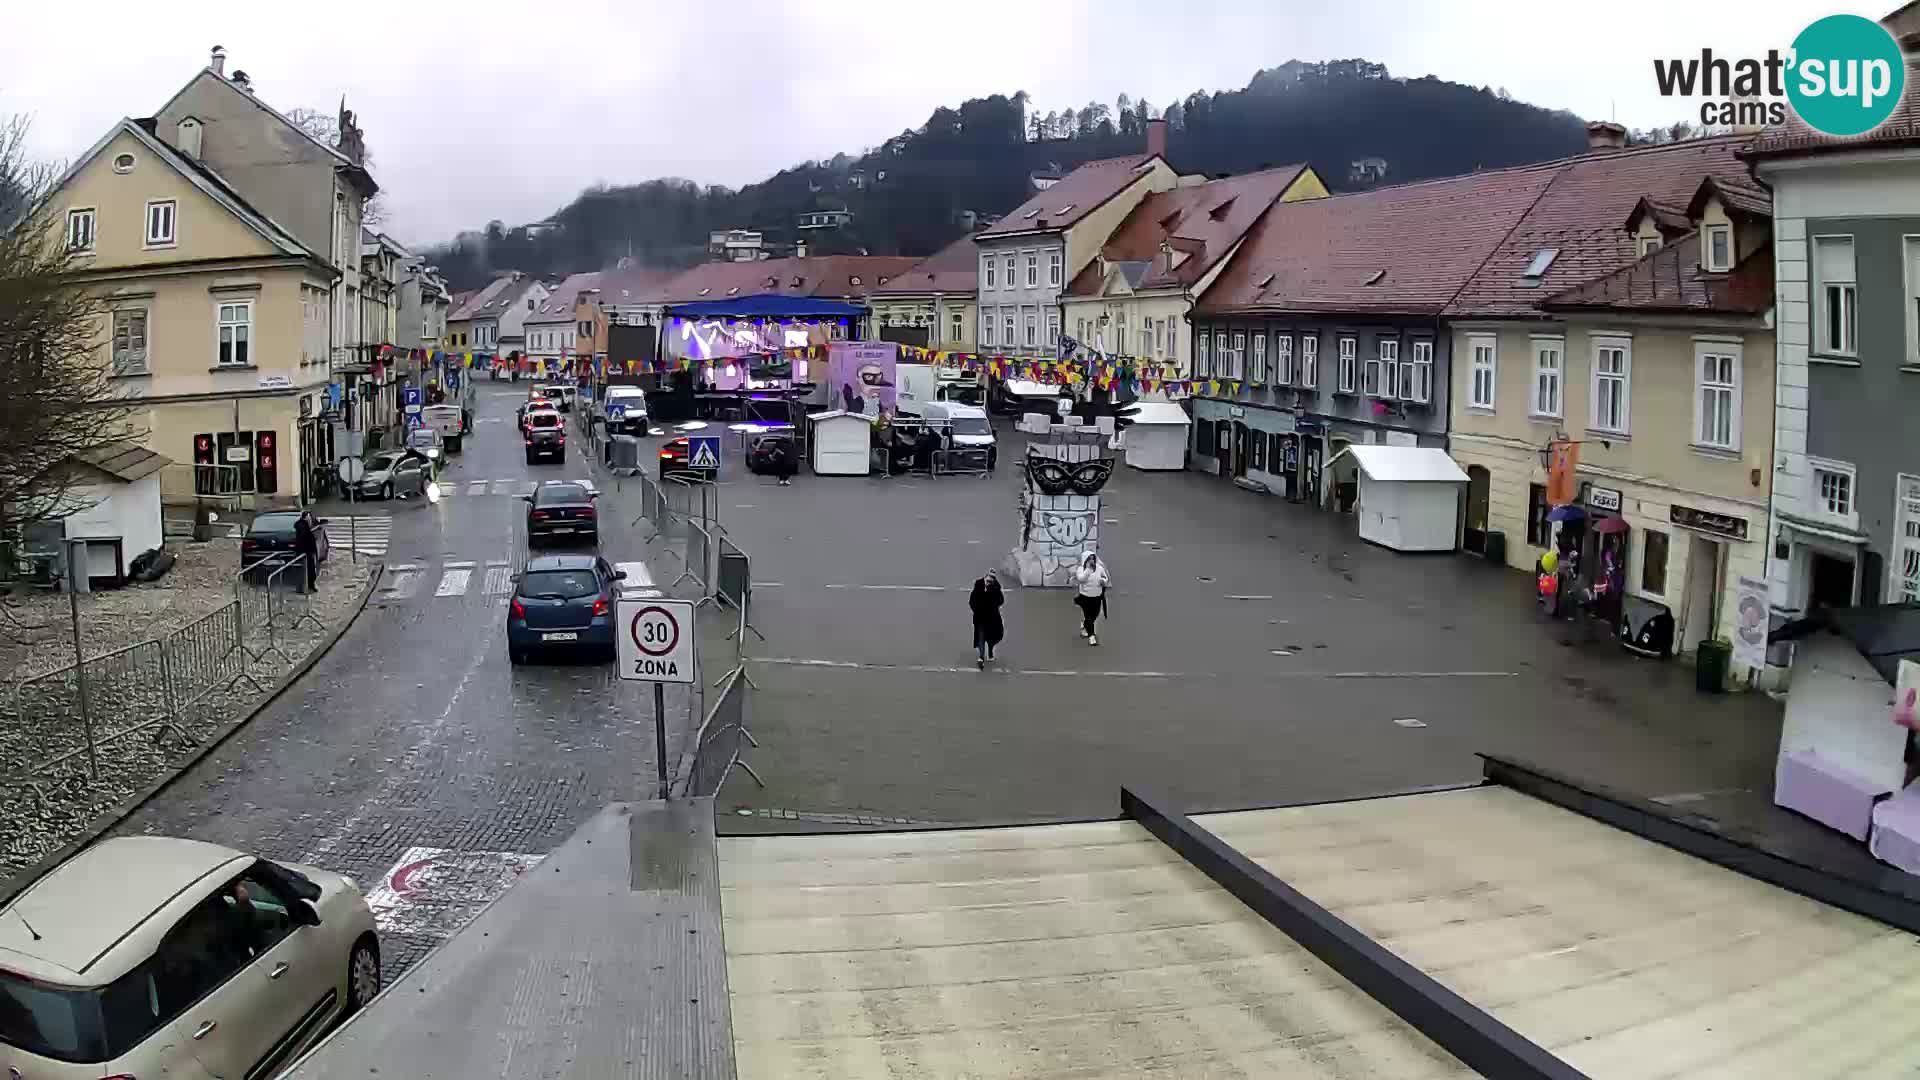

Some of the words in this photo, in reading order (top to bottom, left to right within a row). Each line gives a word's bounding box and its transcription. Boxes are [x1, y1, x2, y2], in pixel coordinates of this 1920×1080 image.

[408, 391, 417, 403] P
[643, 622, 668, 643] 30
[634, 659, 679, 677] ZONA
